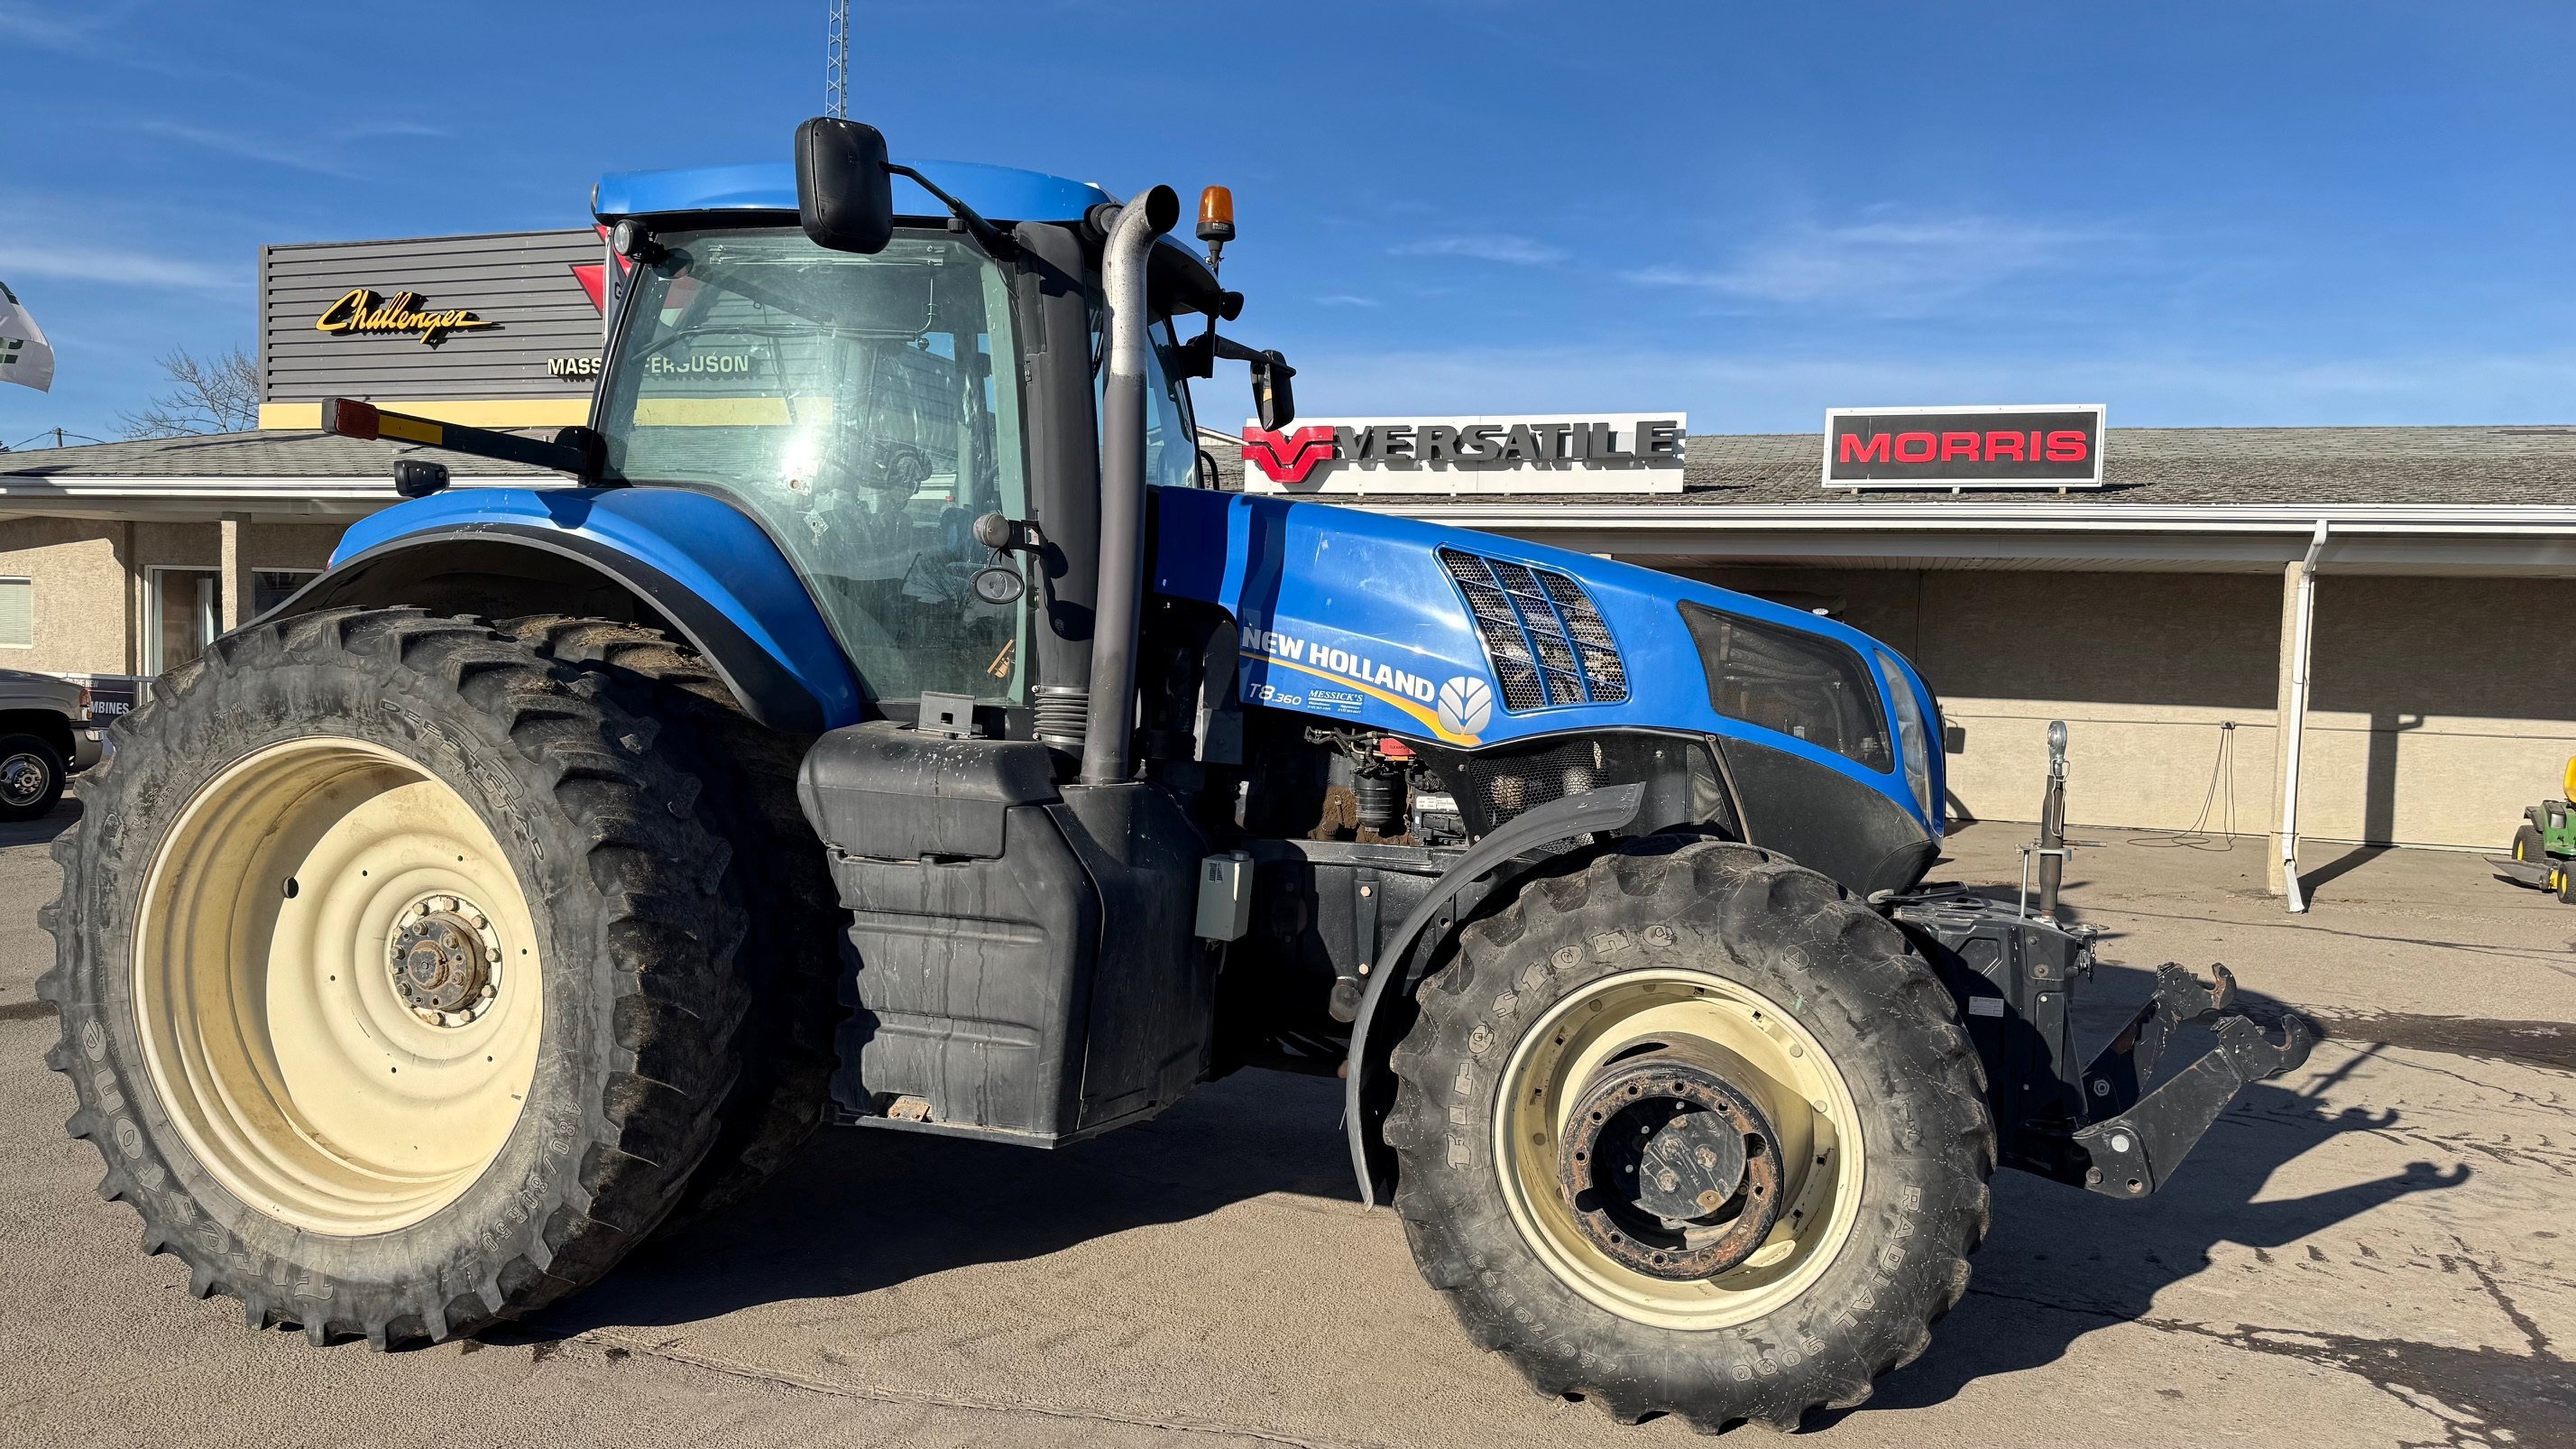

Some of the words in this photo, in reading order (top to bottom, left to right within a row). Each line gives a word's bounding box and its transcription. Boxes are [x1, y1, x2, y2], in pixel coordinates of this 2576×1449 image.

[316, 289, 492, 344] Challenger
[547, 357, 603, 374] MASS
[645, 355, 749, 373] ERGUSON
[1336, 420, 1678, 460] VERSATILE
[1840, 431, 2087, 463] MORRIS
[1242, 626, 1304, 660] NEW
[1309, 642, 1435, 702] HOLLAND
[1309, 689, 1363, 701] MESSICK'S
[90, 701, 130, 715] MBINES
[380, 699, 463, 751] DEEP
[470, 753, 545, 860] TREAD
[1447, 925, 1675, 1171] Firestone
[80, 1018, 335, 1301] Firestone
[482, 1101, 583, 1252] 480/80R50
[1834, 1185, 1922, 1329] RADIAL
[1468, 1252, 1617, 1374] 480/70R34
